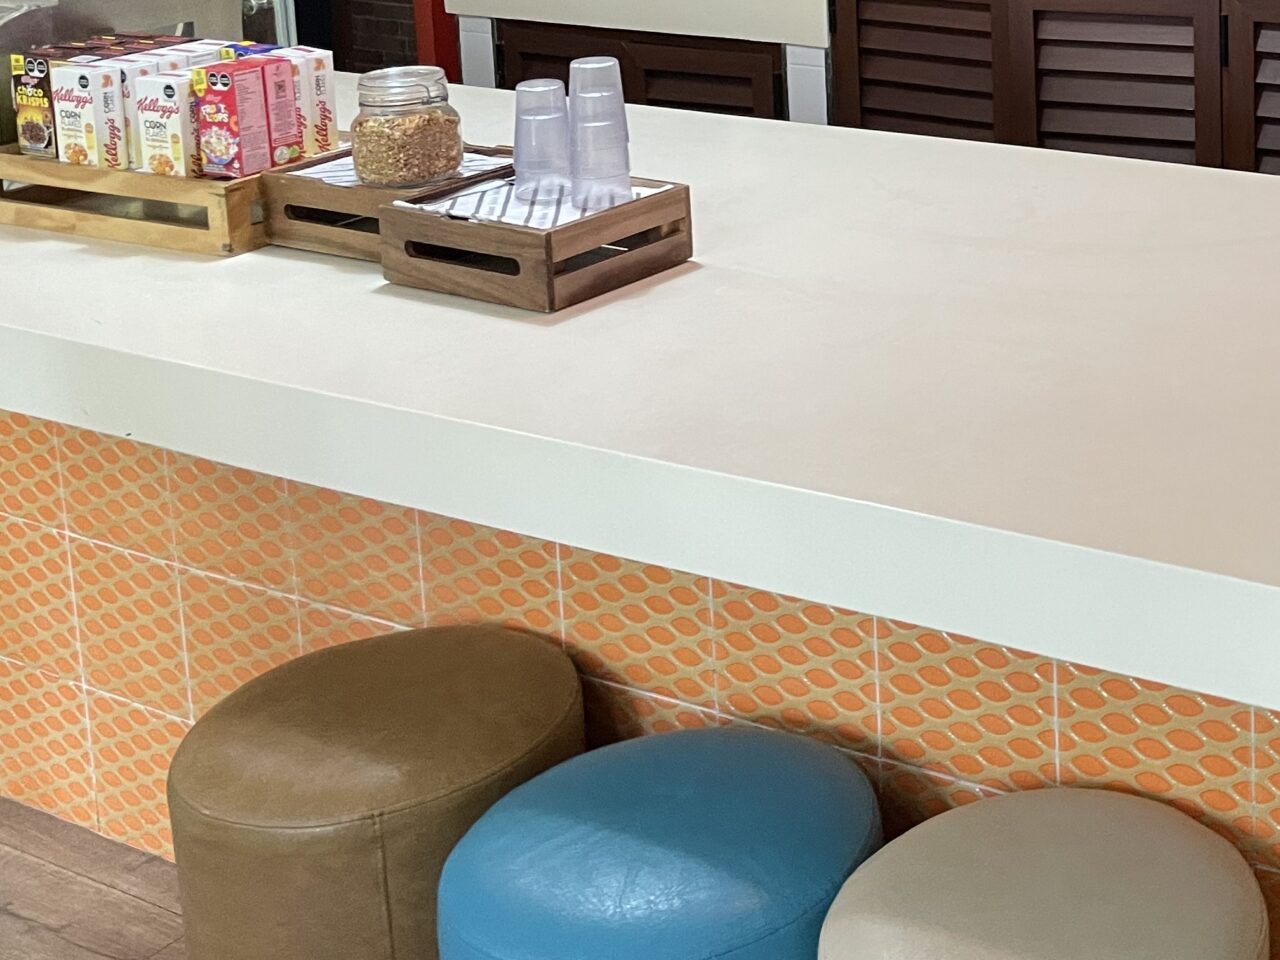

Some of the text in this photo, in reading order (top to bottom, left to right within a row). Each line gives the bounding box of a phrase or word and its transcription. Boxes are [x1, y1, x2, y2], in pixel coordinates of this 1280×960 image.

[52, 86, 93, 109] Kellogg's
[137, 96, 180, 119] Kellogg's
[60, 109, 81, 119] CORN
[144, 120, 167, 129] CORN
[314, 100, 332, 152] Kellogg's
[104, 118, 121, 168] Kellogg's
